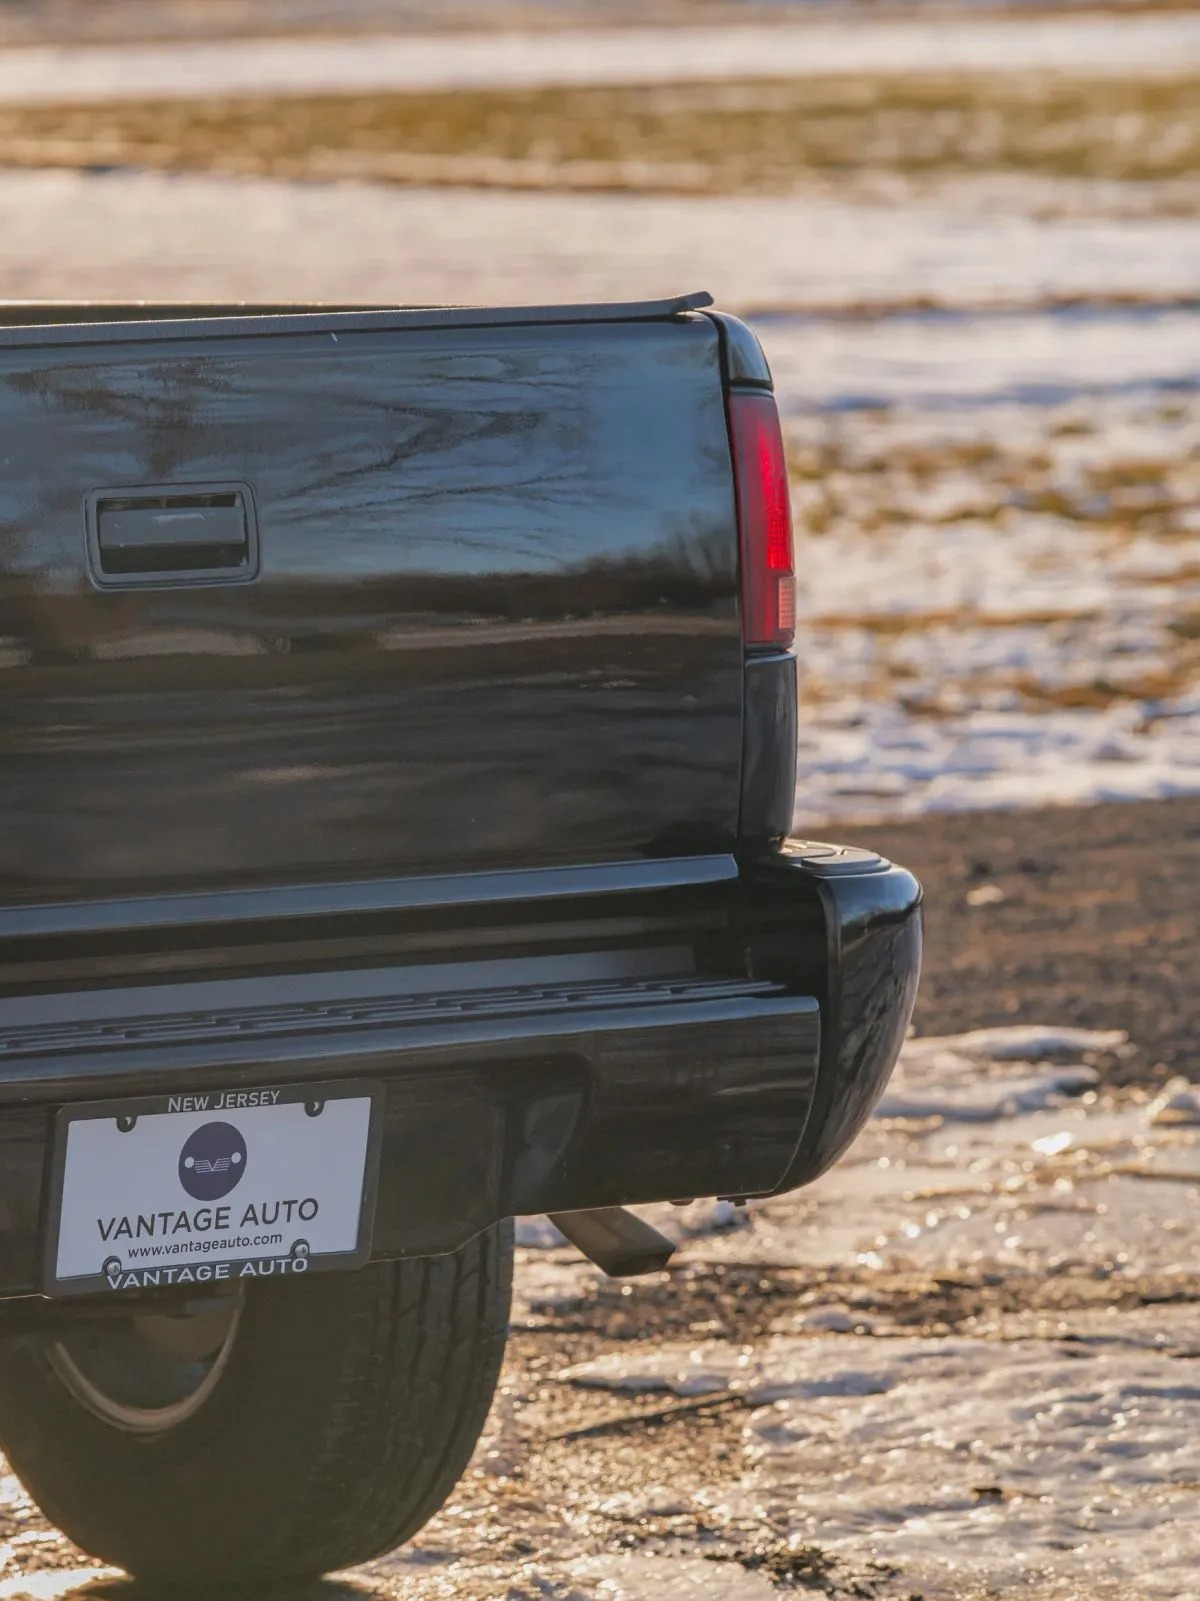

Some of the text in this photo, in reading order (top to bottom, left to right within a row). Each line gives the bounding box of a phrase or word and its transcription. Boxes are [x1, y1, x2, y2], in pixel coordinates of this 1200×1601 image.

[168, 1090, 280, 1113] NEW JERSEY
[97, 1197, 319, 1242] VANTAGE AUTO
[127, 1232, 282, 1259] www.vantageauto.com
[107, 1257, 308, 1290] VANTAGE AUTO
